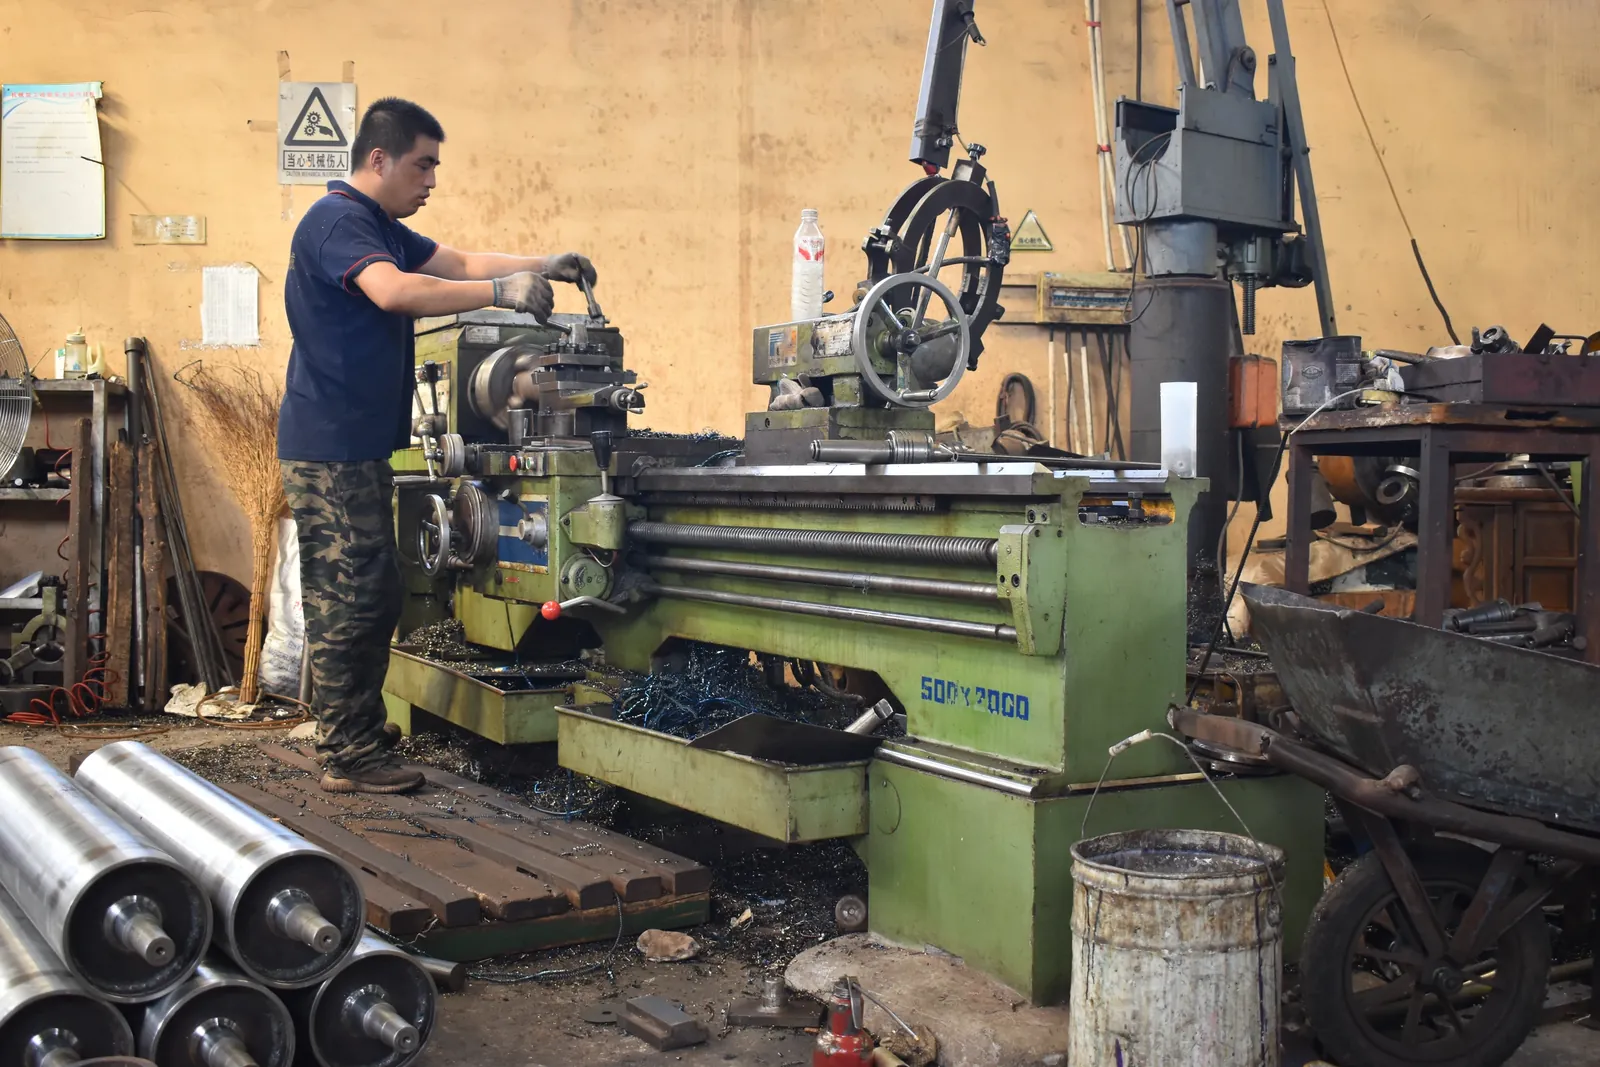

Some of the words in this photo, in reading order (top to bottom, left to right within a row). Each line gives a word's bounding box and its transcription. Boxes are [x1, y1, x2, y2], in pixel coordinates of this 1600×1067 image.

[287, 153, 345, 168] 当心机械伤人
